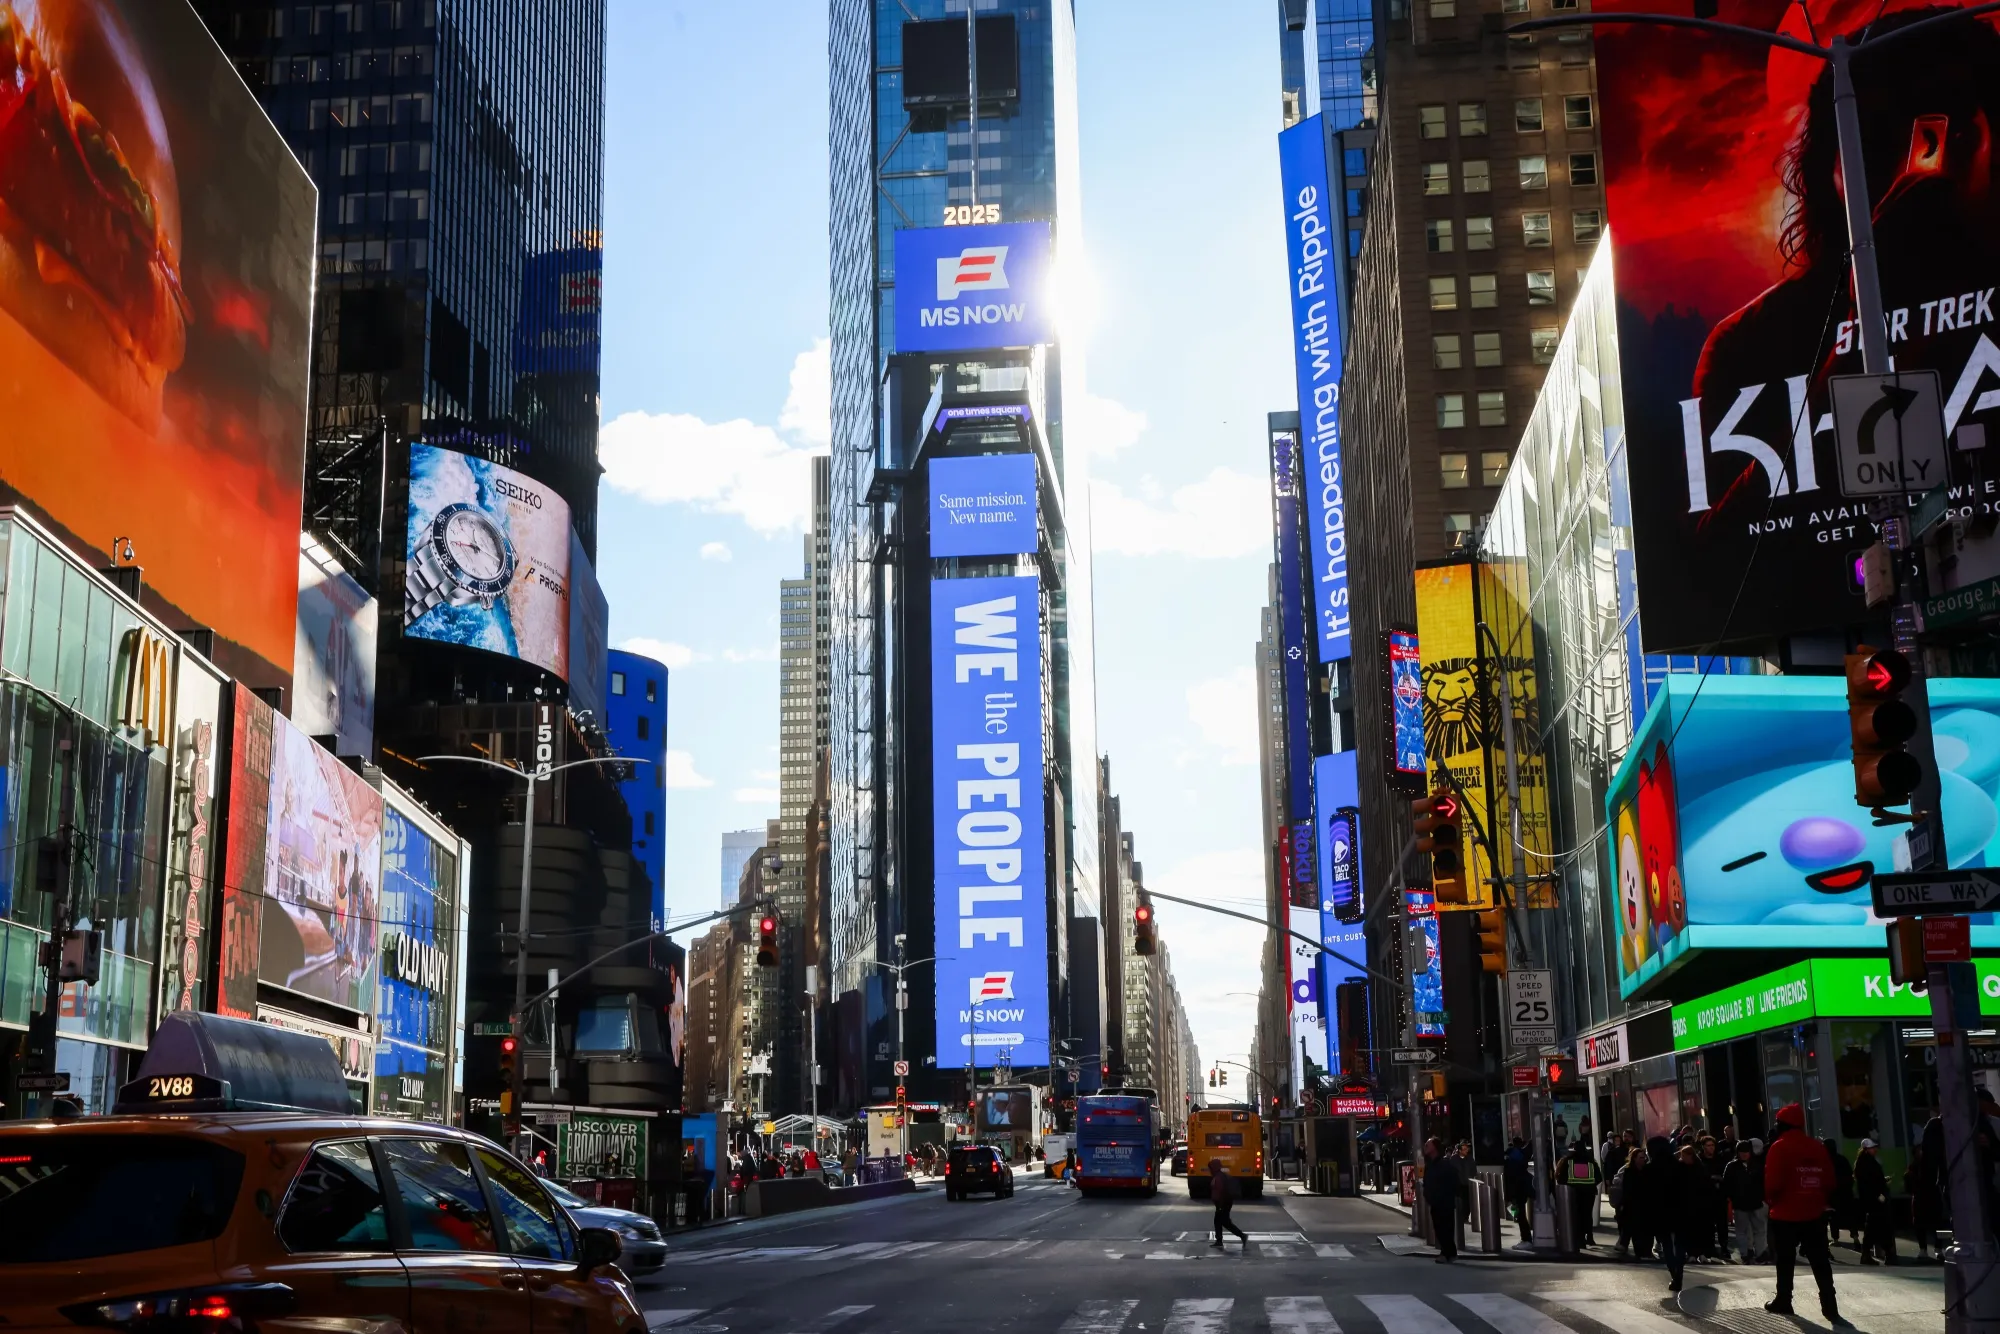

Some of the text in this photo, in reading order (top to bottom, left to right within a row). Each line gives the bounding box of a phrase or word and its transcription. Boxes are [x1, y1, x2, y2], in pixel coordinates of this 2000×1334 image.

[943, 204, 1000, 226] 2025
[920, 303, 1026, 328] MS NOW
[1836, 287, 1995, 355] SR TREK
[967, 407, 990, 416] times
[991, 405, 1022, 417] square
[1293, 185, 1350, 640] It's happening with Ripple
[496, 478, 542, 510] SEIKO
[939, 492, 1027, 508] Same mission.
[949, 510, 1017, 525] New name.
[1748, 516, 1794, 536] NOW
[1808, 492, 1928, 525] AVAILL
[1816, 525, 1857, 543] GET
[1926, 588, 1984, 617] George
[536, 705, 552, 781] 1500
[954, 595, 1024, 949] WE the PEOPLE
[1334, 864, 1349, 874] TACO
[1335, 873, 1349, 882] BELL
[1894, 883, 1990, 903] ONE WAY
[1925, 921, 1934, 930] NO
[225, 900, 260, 981] FAN
[397, 931, 448, 995] OLD NAVY
[1515, 1001, 1549, 1022] 25
[1697, 1008, 1715, 1030] KPOP
[1716, 999, 1744, 1026] SQUARE
[1746, 995, 1755, 1017] BY
[1759, 988, 1775, 1013] LINE
[1776, 978, 1808, 1008] FRIENDS
[960, 1008, 1025, 1023] MS NOW
[1425, 1013, 1432, 1023] W
[1432, 1012, 1442, 1022] 45
[483, 1024, 491, 1033] W
[1596, 1035, 1619, 1064] TISSOT
[1682, 1062, 1698, 1077] BLACK
[149, 1076, 193, 1099] 2V88
[402, 1077, 424, 1099] OLD NAVY
[567, 1121, 637, 1135] DISCOVER
[566, 1134, 637, 1166] BROADWAY'S
